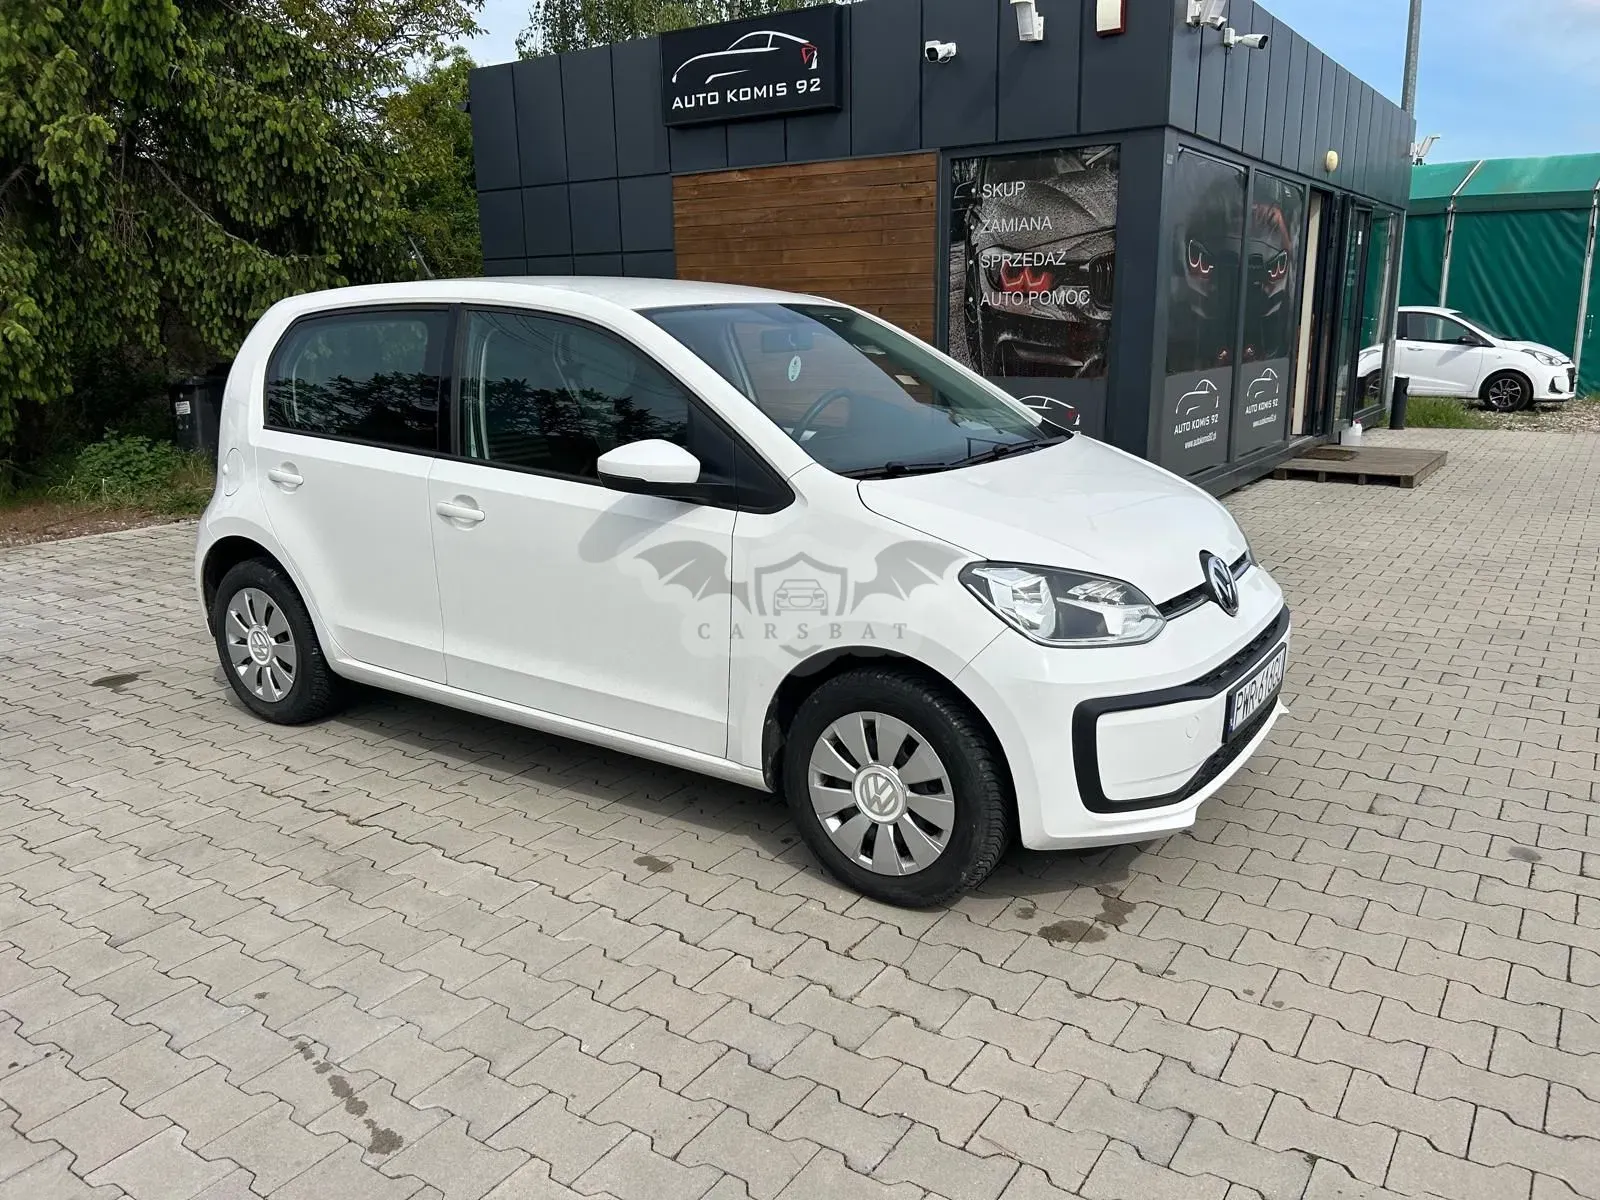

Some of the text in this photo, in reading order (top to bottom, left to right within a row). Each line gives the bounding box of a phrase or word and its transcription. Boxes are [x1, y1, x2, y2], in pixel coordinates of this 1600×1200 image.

[672, 77, 821, 110] AUTO KOMIS 92
[981, 181, 1026, 198] SKUP
[980, 215, 1053, 234] ZAMIANA
[981, 248, 1066, 268] SPRZEDAŻ
[980, 289, 1091, 307] AUTO POMOC
[1245, 403, 1258, 415] AUTO
[1173, 413, 1219, 435] AUTO KOMIS 92
[1235, 680, 1256, 726] PWR
